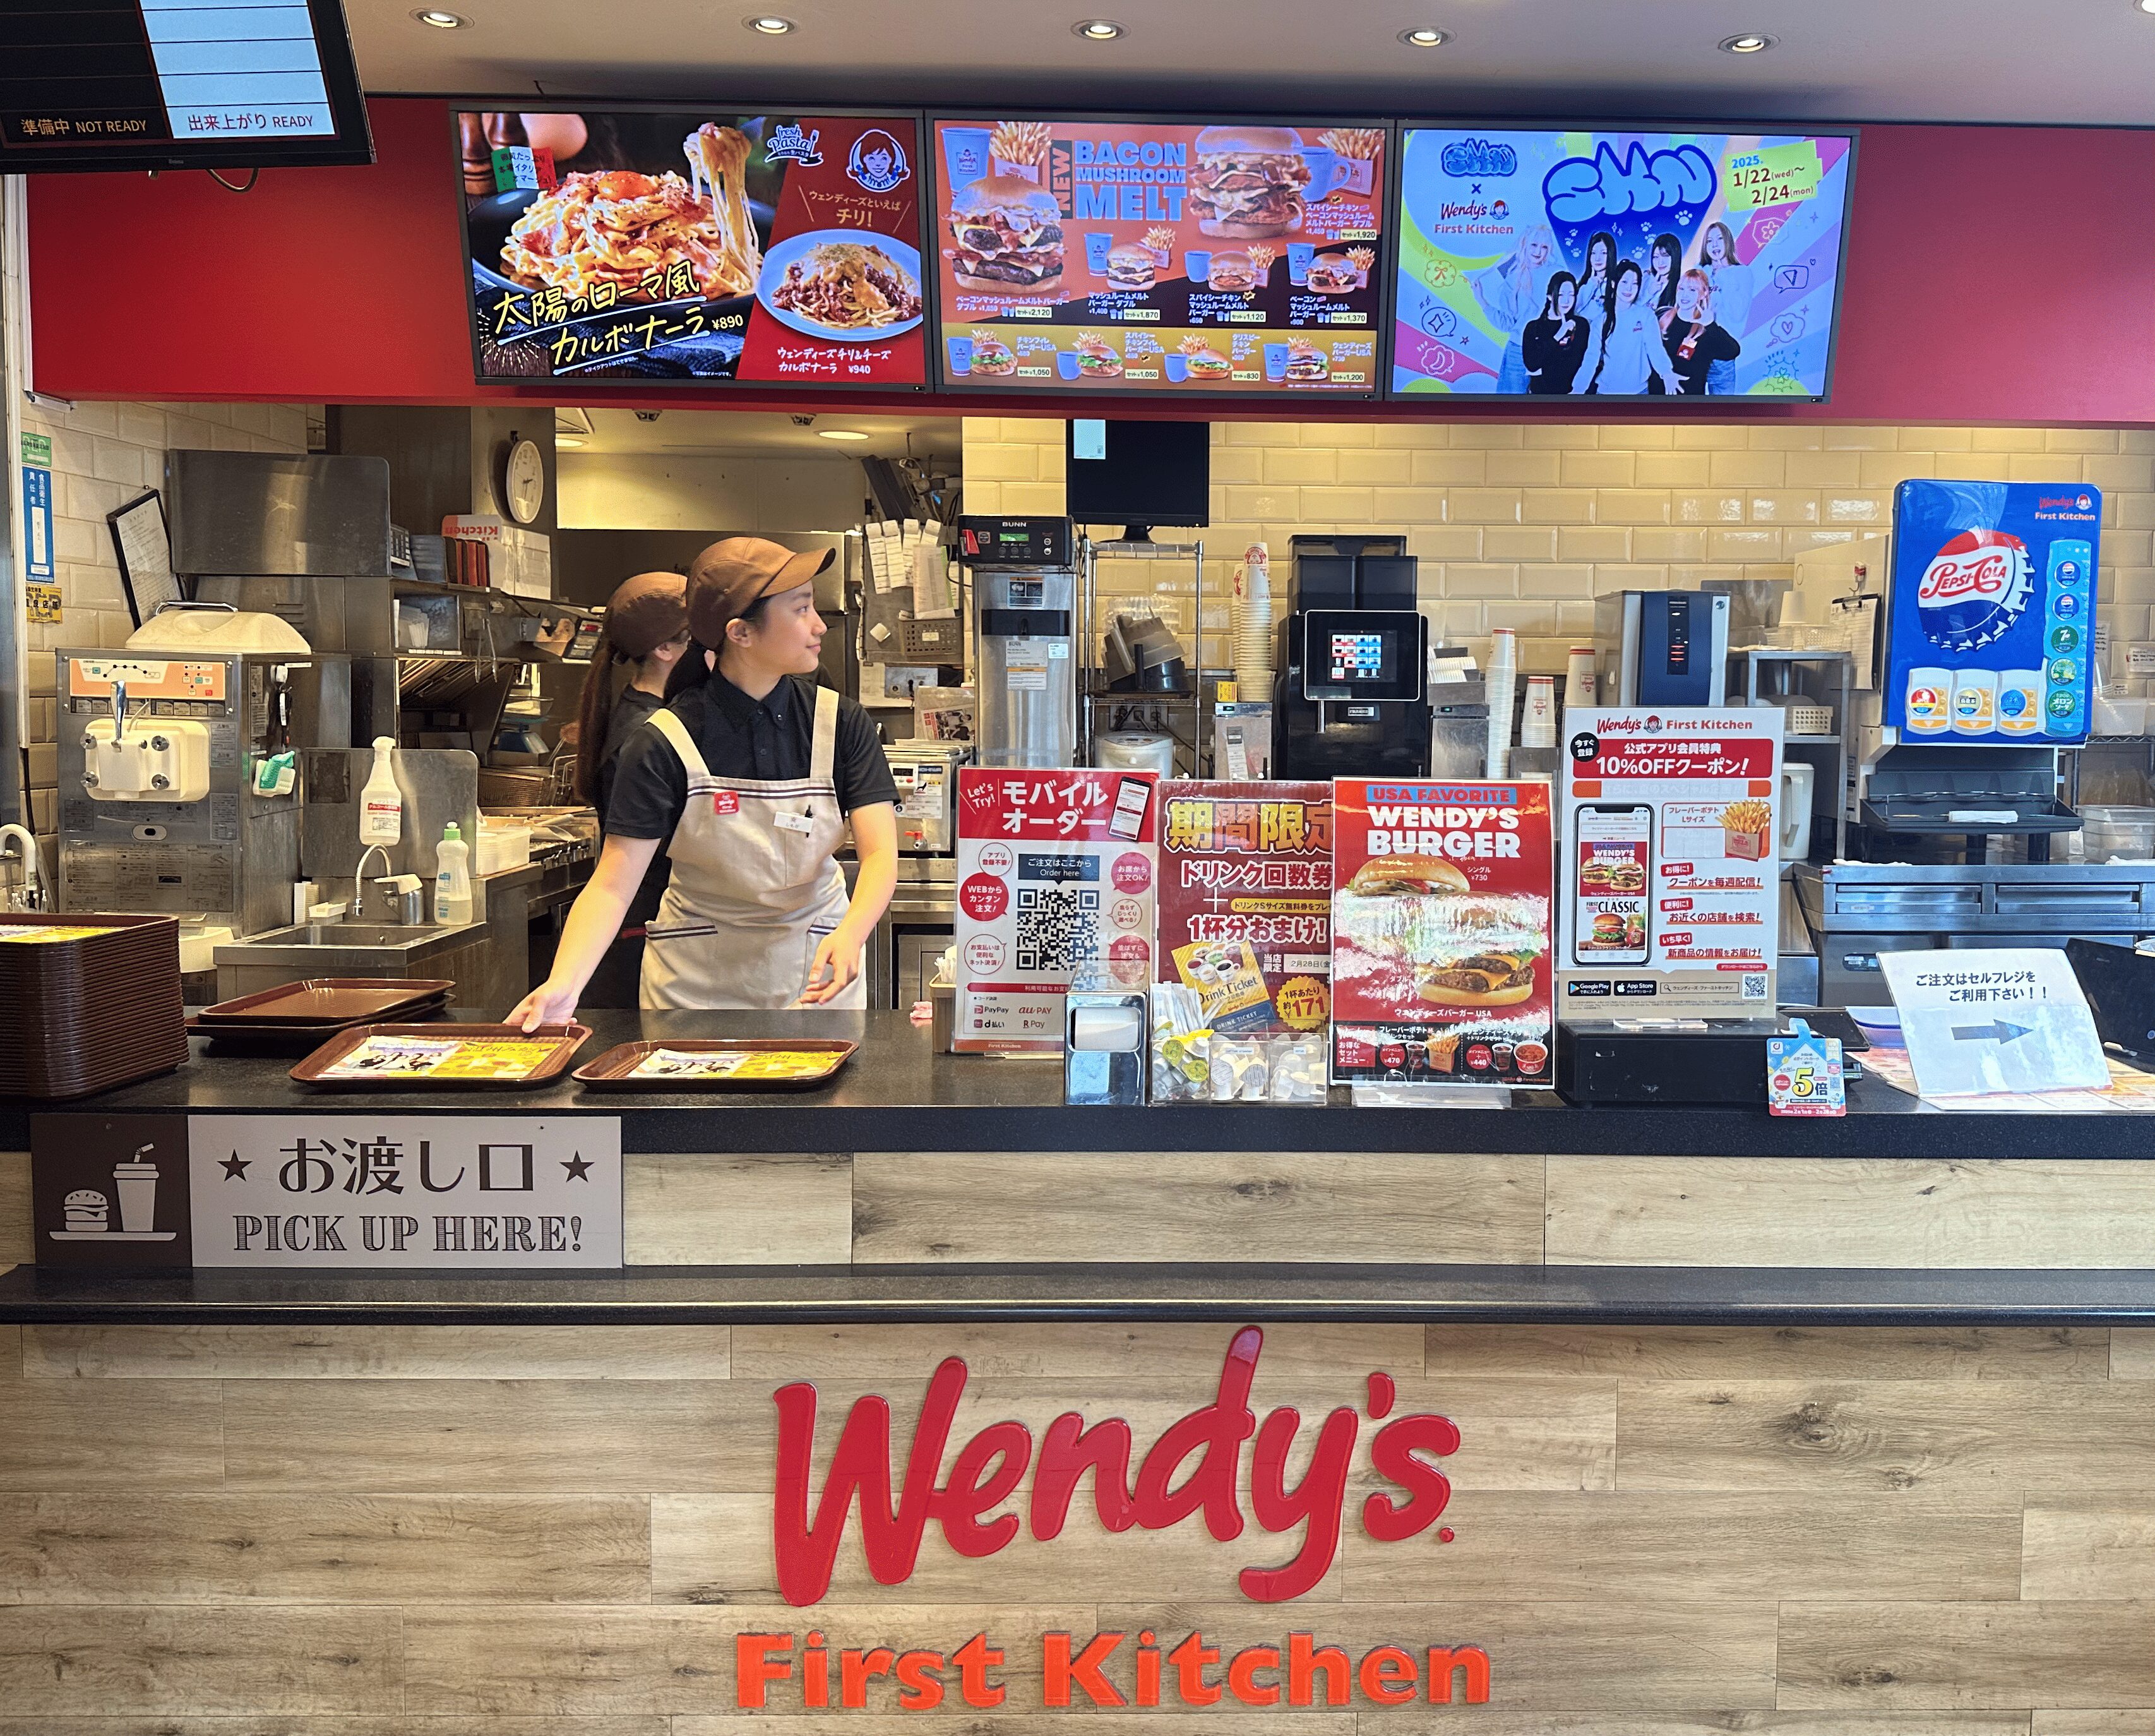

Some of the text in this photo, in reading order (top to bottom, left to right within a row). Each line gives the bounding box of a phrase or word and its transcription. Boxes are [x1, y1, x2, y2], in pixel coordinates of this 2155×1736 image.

[21, 119, 147, 136] 準備中 NOT READY
[188, 114, 313, 131] 出来上がり READY
[777, 126, 800, 140] fresh
[769, 137, 808, 151] Pasta
[1075, 141, 1186, 166] BACON
[1056, 147, 1071, 212] NEW
[1076, 168, 1186, 183] MUSHROOM
[809, 191, 900, 212] ウェンディーズといえば
[1752, 184, 1813, 205] 2/24(mon)
[1076, 184, 1187, 221] MELT
[1441, 200, 1487, 220] Wendy's
[837, 208, 873, 227] チリ!
[1435, 224, 1513, 234] First Kitchen
[494, 260, 700, 333] 太陽のローマ風
[956, 296, 1070, 306] ベーコンマッシュルームメルトバーガー
[1189, 294, 1241, 302] スパイシーチキン
[552, 307, 743, 364] カルボナーラ ¥890
[779, 362, 871, 374] カルボナーラ ¥940
[2035, 512, 2096, 521] First Kitchen
[1597, 715, 1752, 734] Wendy's First Kitchen
[1577, 748, 1594, 757] 登録
[1625, 743, 1721, 755] 公式アプリ会員特典
[1596, 757, 1749, 775] 10%OFFクーポン!
[967, 782, 993, 798] Let's
[1003, 779, 1109, 806] モバイル
[1374, 788, 1510, 802] USA FAVORITE
[972, 794, 996, 808] Try!
[1003, 808, 1106, 835] オーダー
[1367, 806, 1519, 829] WENDY'S
[1368, 830, 1521, 858] BURGER
[1028, 858, 1092, 867] ご注文はここから
[1593, 857, 1635, 865] BURGER
[1181, 859, 1332, 890] ドリンク回数券
[1665, 865, 1690, 874] お得に!
[1116, 873, 1148, 882] 注文OK!
[1669, 878, 1760, 887] クーポンを毎週配信!
[967, 885, 1003, 894] WEBから
[969, 895, 1000, 903] カンタン
[1664, 900, 1689, 909] 便利に!
[974, 904, 996, 913] 注文!
[1598, 901, 1639, 913] CLASSIC
[1669, 913, 1760, 922] お近くの店舗を検索!
[1187, 914, 1327, 943] 1杯分おまけ!
[1662, 935, 1691, 944] いち早く!
[1263, 954, 1282, 963] 当店
[1668, 948, 1762, 958] 新商品の情報をお届け!
[1263, 963, 1282, 973] 限定
[1224, 976, 1258, 993] Ticket
[1916, 971, 2036, 986] ご注文はセルフレジを
[1284, 986, 1320, 999] 1杯あたり
[1949, 986, 2047, 1002] ご利用下さい！！
[984, 1006, 1009, 1014] PayPay
[1292, 996, 1325, 1017] 171
[1237, 1010, 1257, 1022] TICKET
[1030, 1021, 1045, 1029] Pay
[1379, 1026, 1427, 1034] フレーバーポテト
[1792, 1067, 1827, 1097] 5 倍
[279, 1135, 534, 1195] お渡し口
[233, 1214, 583, 1252] PICK UP HERE!
[773, 1324, 1461, 1607] Wendy's
[736, 1630, 1491, 1709] First Kitchen
